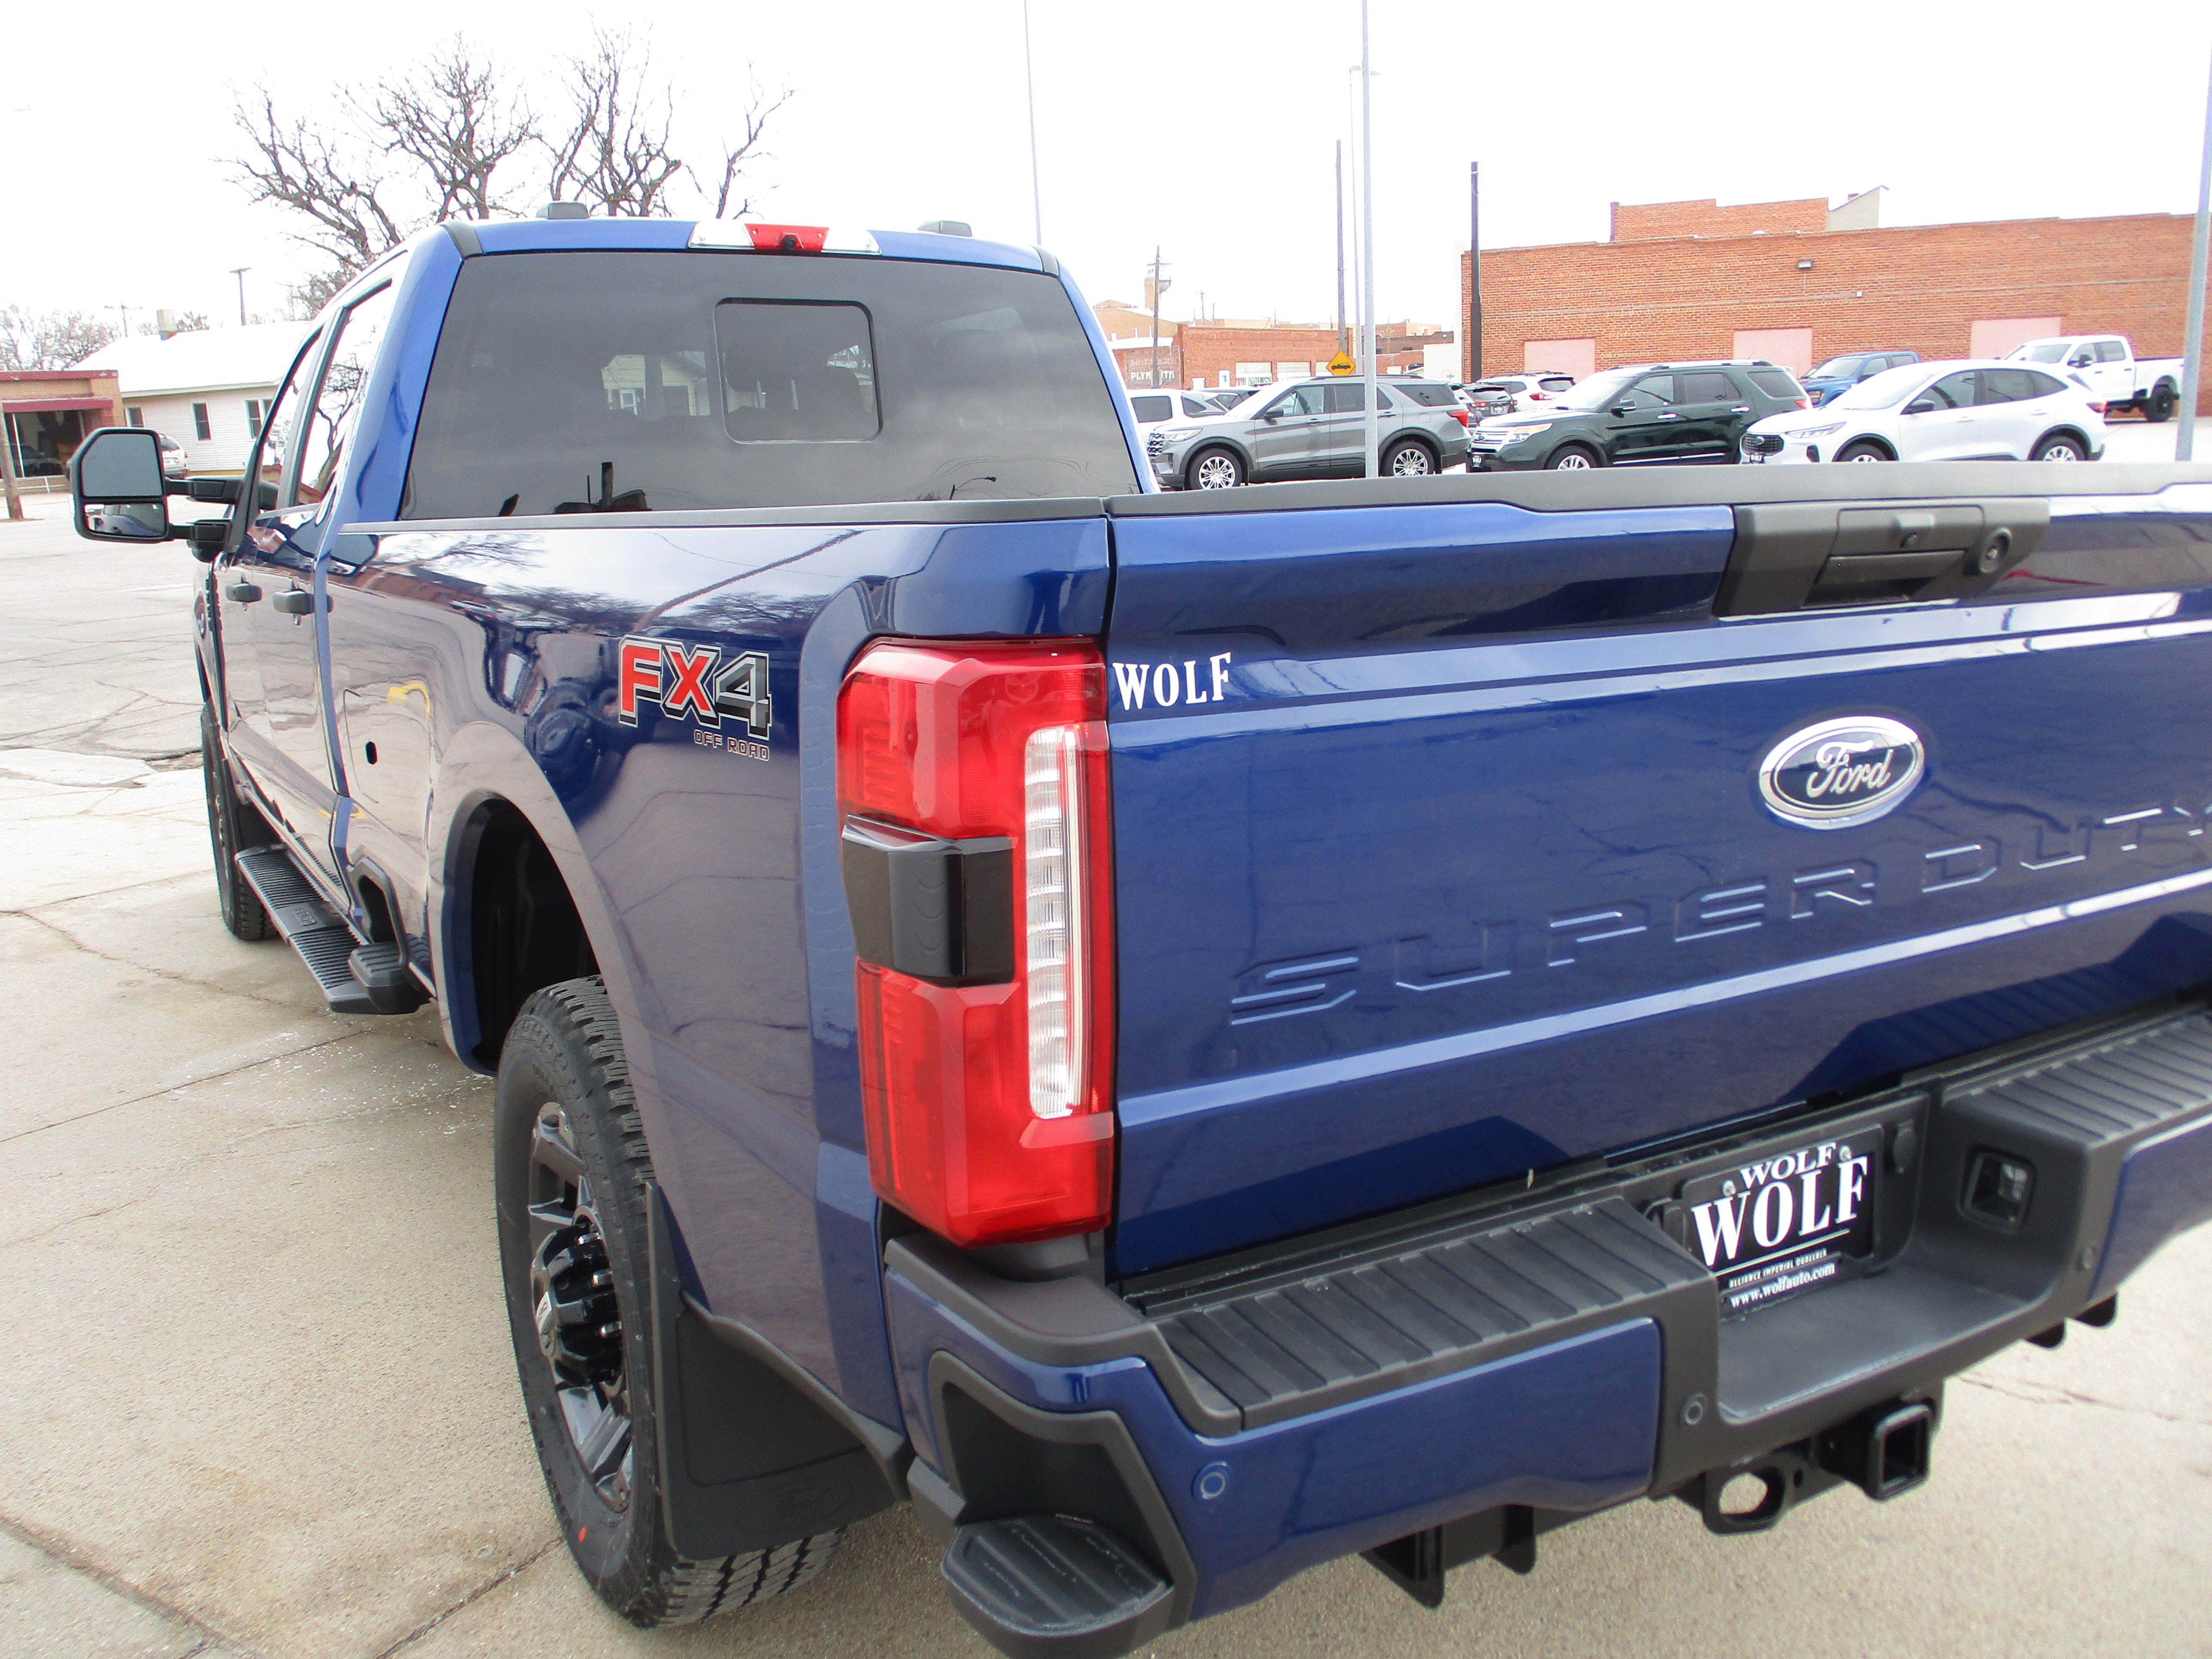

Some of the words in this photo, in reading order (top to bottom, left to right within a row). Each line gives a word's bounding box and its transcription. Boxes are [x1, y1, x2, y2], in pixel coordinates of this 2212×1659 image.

[1130, 370, 1175, 380] PLYMTH
[618, 634, 772, 741] FX4
[1112, 652, 1231, 711] WOLF
[693, 729, 723, 749] OFF
[727, 737, 769, 762] ROAD
[1806, 739, 1893, 798] Ford
[1231, 859, 1879, 1025] SUPER
[1740, 1142, 1837, 1189] WOLF
[1691, 1156, 1868, 1267] WOLF
[1730, 1262, 1835, 1308] www.wolfauto.com
